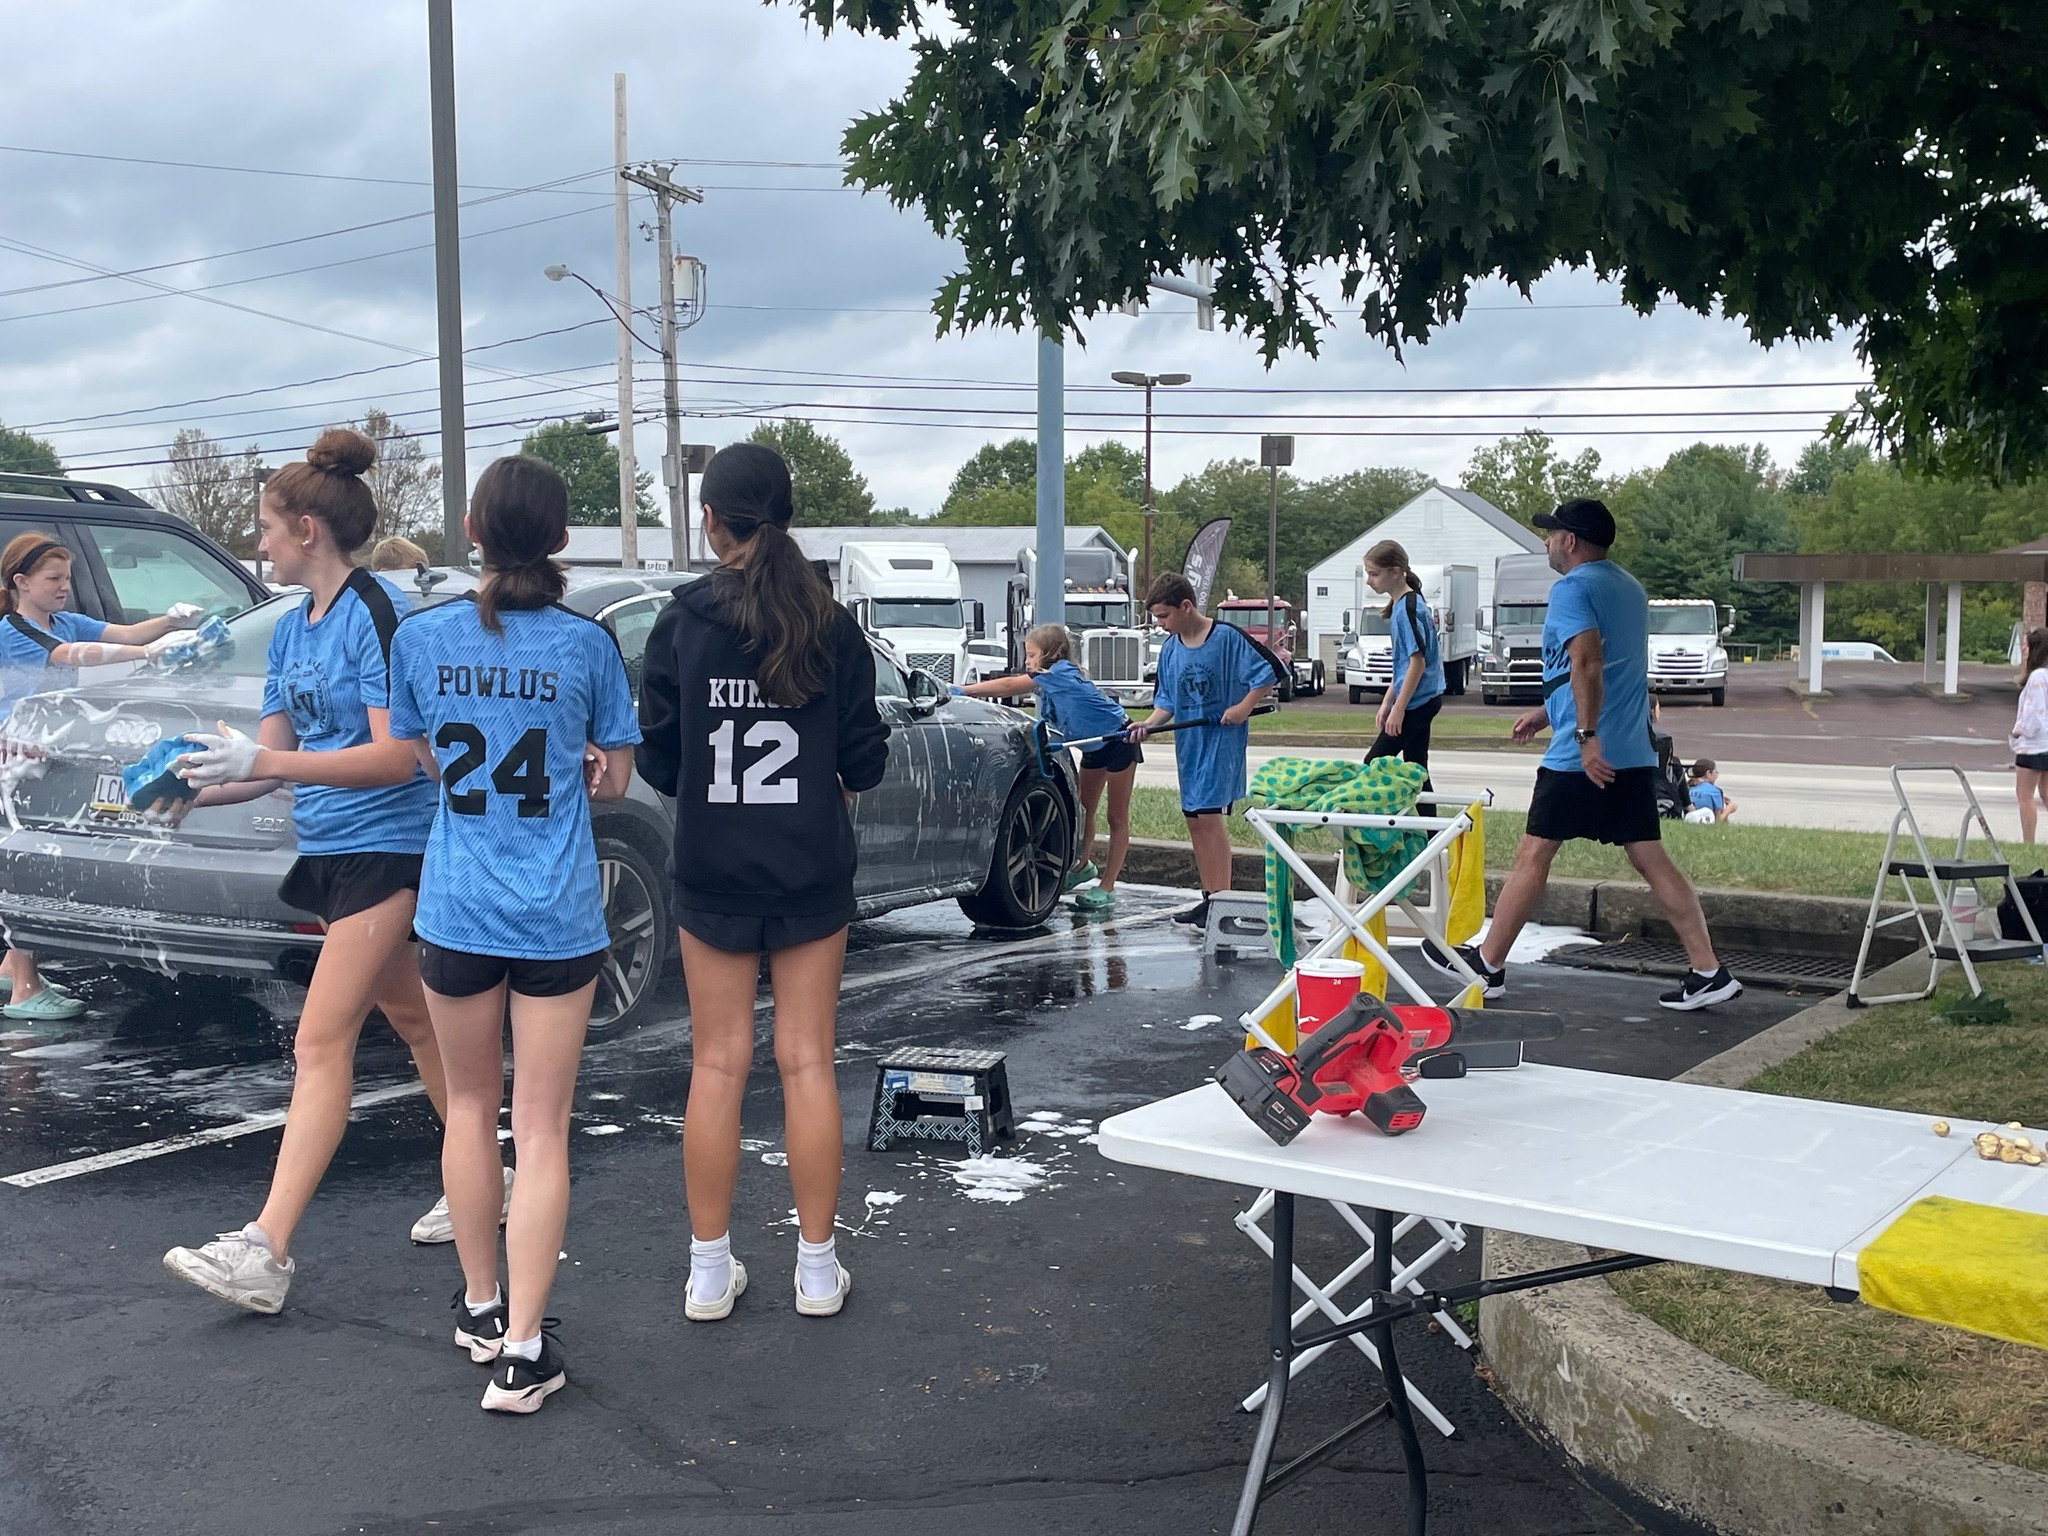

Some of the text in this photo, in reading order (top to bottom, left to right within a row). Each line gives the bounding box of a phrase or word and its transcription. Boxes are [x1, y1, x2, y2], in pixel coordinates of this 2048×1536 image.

[1187, 554, 1203, 589] y's
[1202, 564, 1214, 590] YEARS
[436, 665, 559, 702] POWLUS
[708, 678, 801, 708] KUM
[435, 722, 550, 818] 24
[707, 719, 799, 804] 12
[1332, 978, 1342, 986] 24
